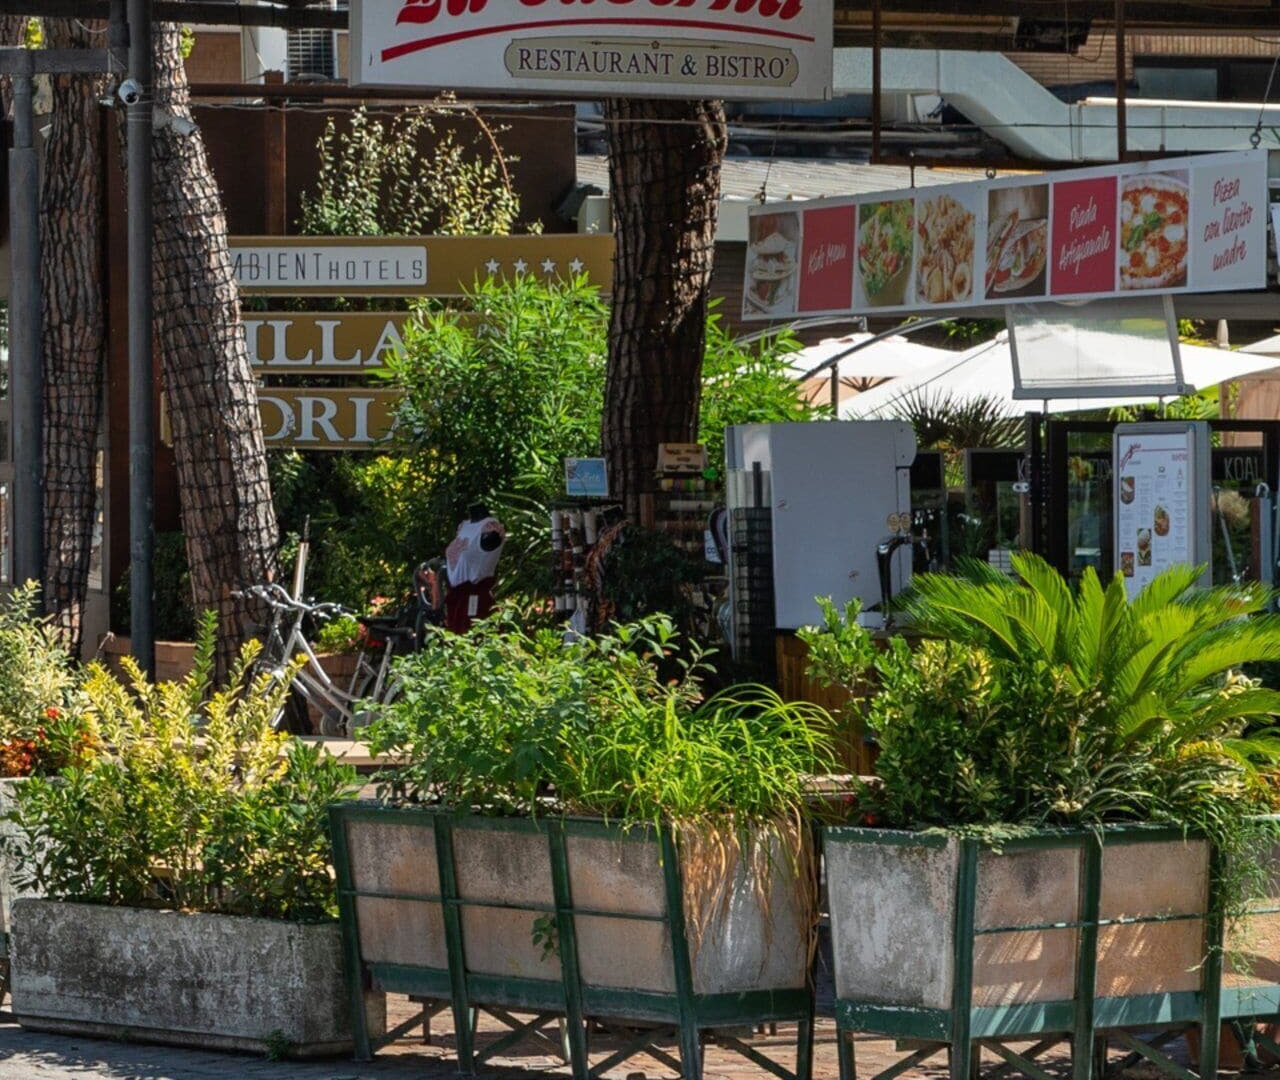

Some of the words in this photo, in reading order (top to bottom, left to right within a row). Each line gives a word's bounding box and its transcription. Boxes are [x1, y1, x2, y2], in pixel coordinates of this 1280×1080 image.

[518, 47, 675, 75] RESTAURANT
[680, 55, 698, 77] &
[1213, 177, 1240, 206] Pizza
[1070, 196, 1097, 232] Piada
[1204, 222, 1220, 242] con
[1223, 202, 1254, 234] lievito
[1059, 225, 1111, 275] Artigianale
[1212, 236, 1248, 271] madre
[329, 259, 423, 281] HOTELS
